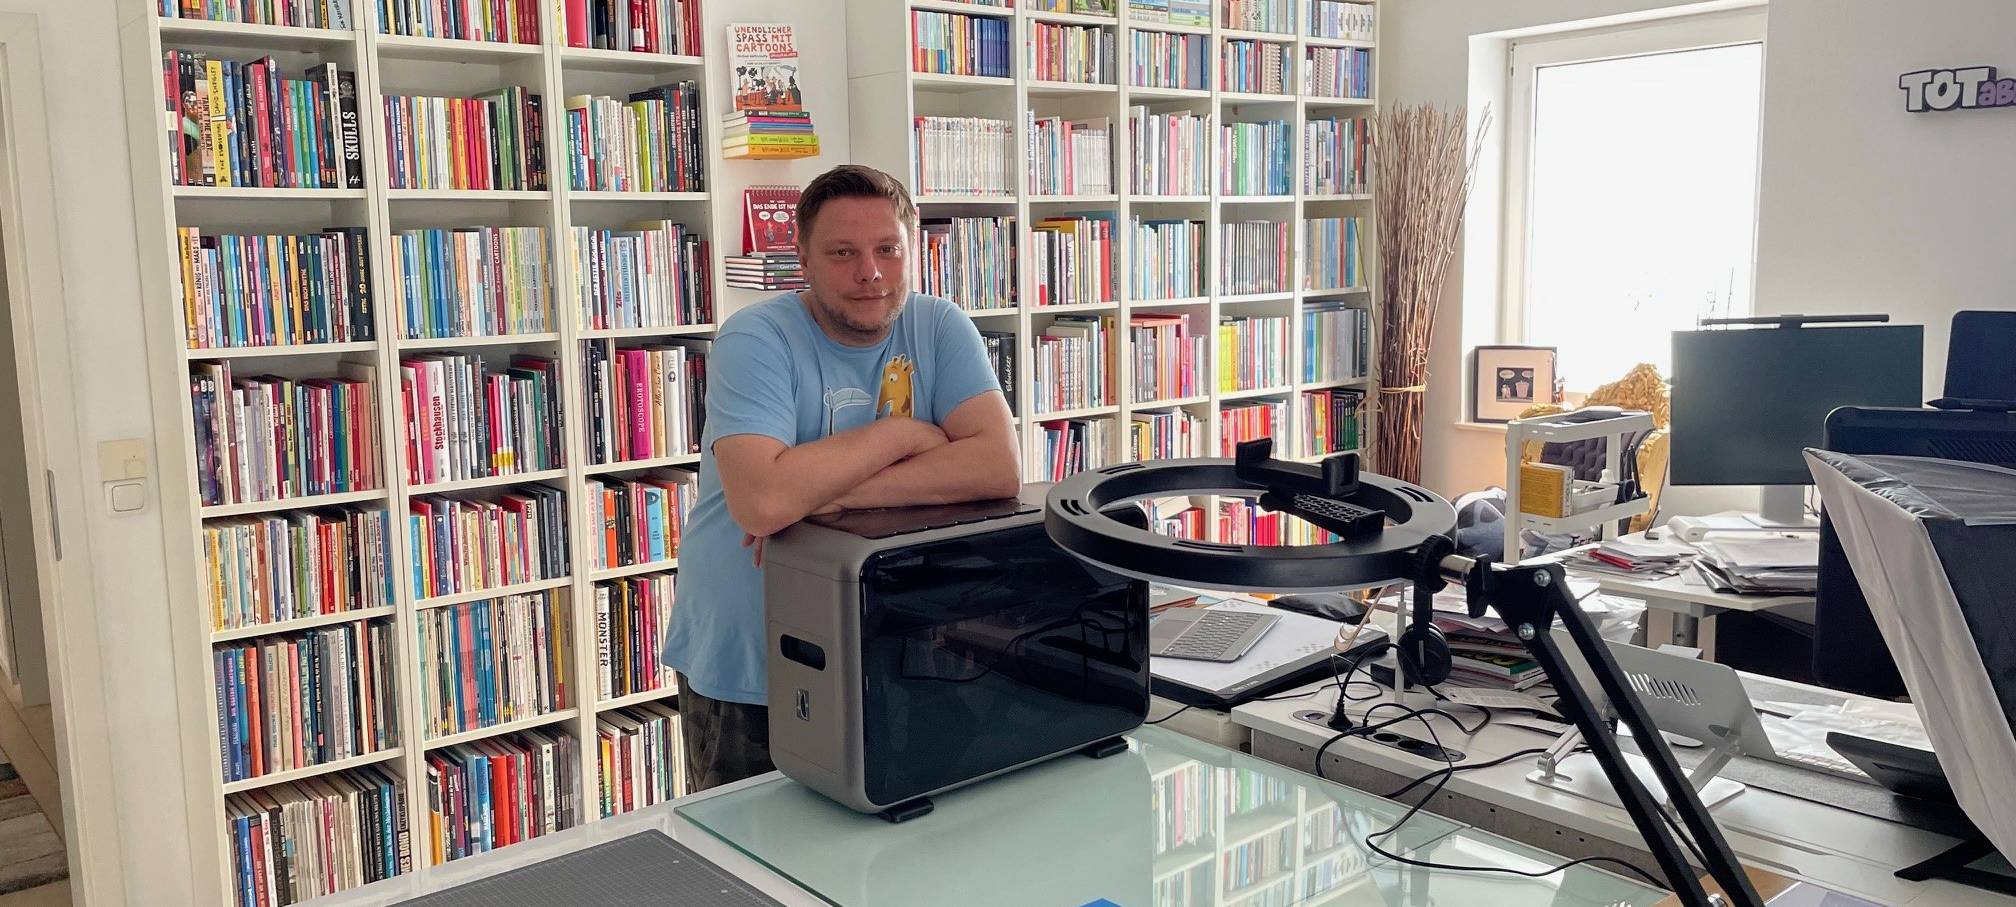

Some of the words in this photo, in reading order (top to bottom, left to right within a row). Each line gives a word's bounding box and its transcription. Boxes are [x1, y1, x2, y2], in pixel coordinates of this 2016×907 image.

[735, 26, 792, 34] UNENDLICHER
[736, 34, 768, 43] SPASS
[771, 34, 792, 42] MIT
[736, 43, 793, 52] CARTOONS
[342, 111, 360, 160] SKULLS
[432, 395, 444, 450] Stockhausen
[636, 382, 645, 432] EROTOSCOPE
[598, 612, 609, 667] MONSTER
[399, 832, 410, 856] BOND
